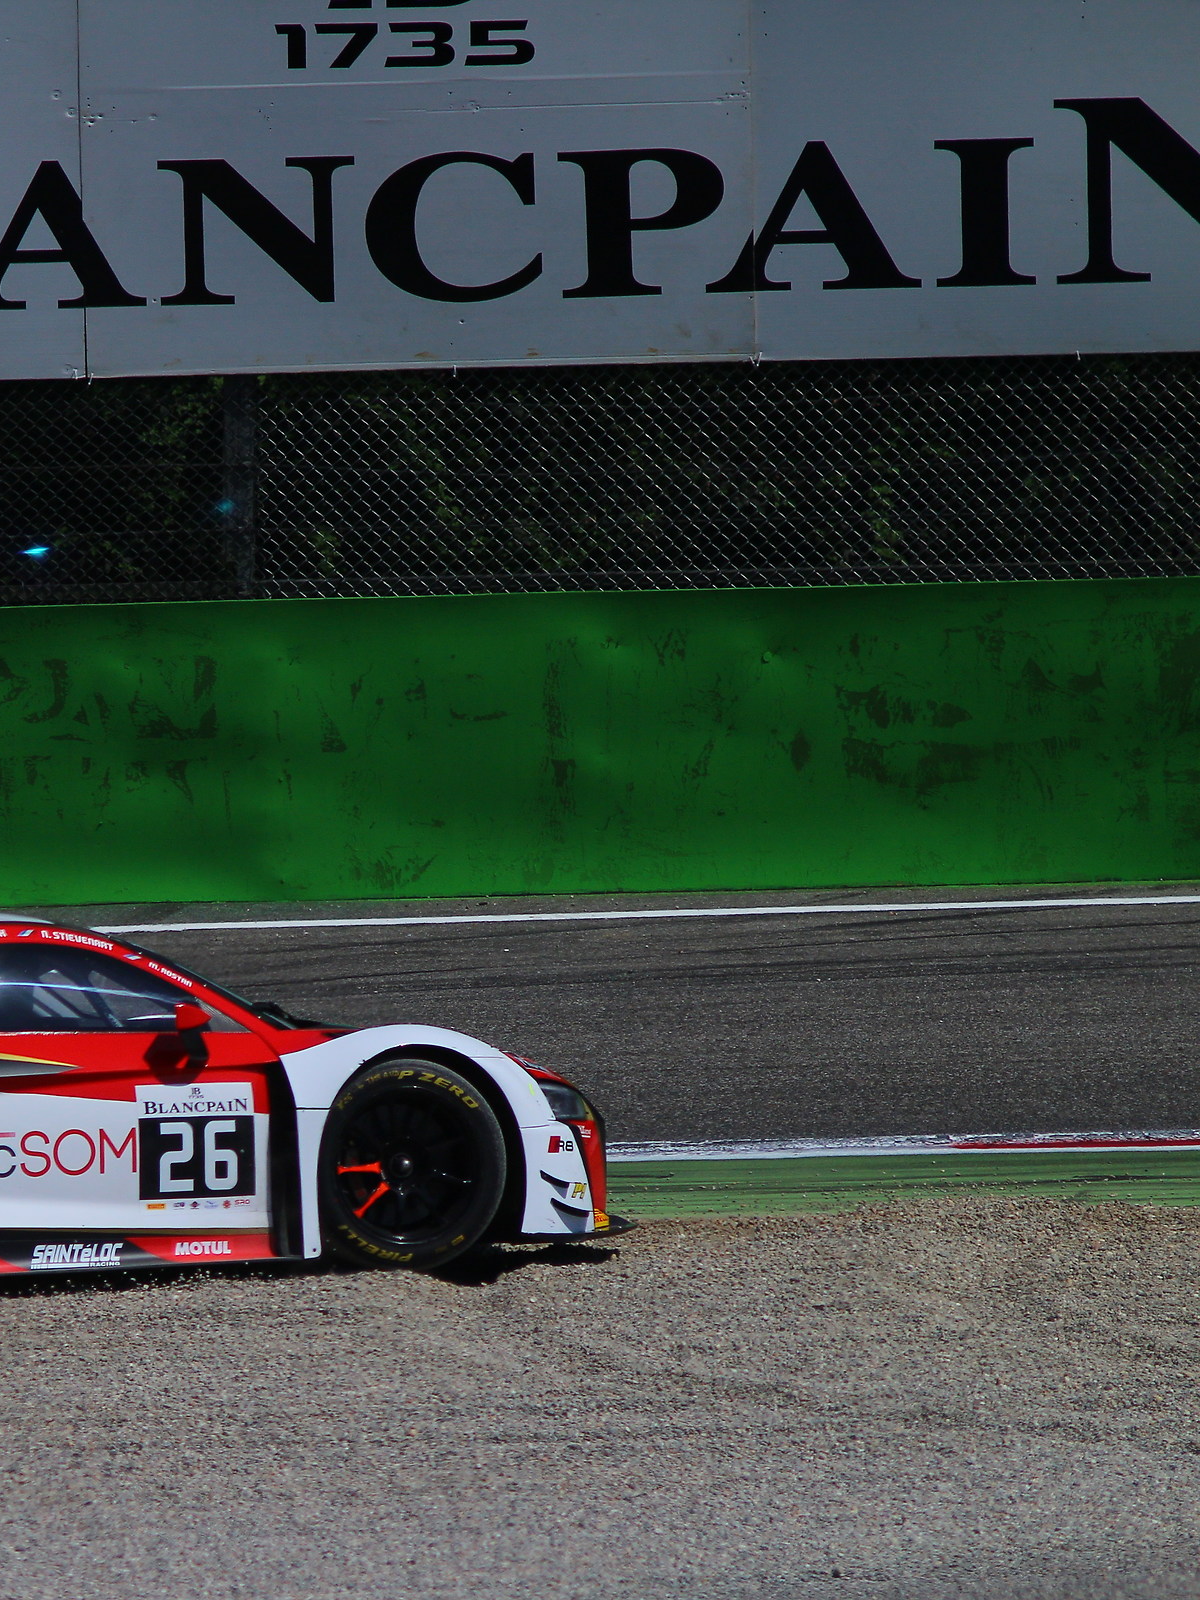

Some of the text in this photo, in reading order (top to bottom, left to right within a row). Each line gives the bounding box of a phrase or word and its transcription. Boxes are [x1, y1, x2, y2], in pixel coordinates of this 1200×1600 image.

[275, 20, 535, 69] 1735
[143, 1098, 248, 1115] BLANCPAIN
[418, 1072, 480, 1110] ZERO
[160, 1120, 238, 1193] 26
[175, 1240, 232, 1256] MOTUL
